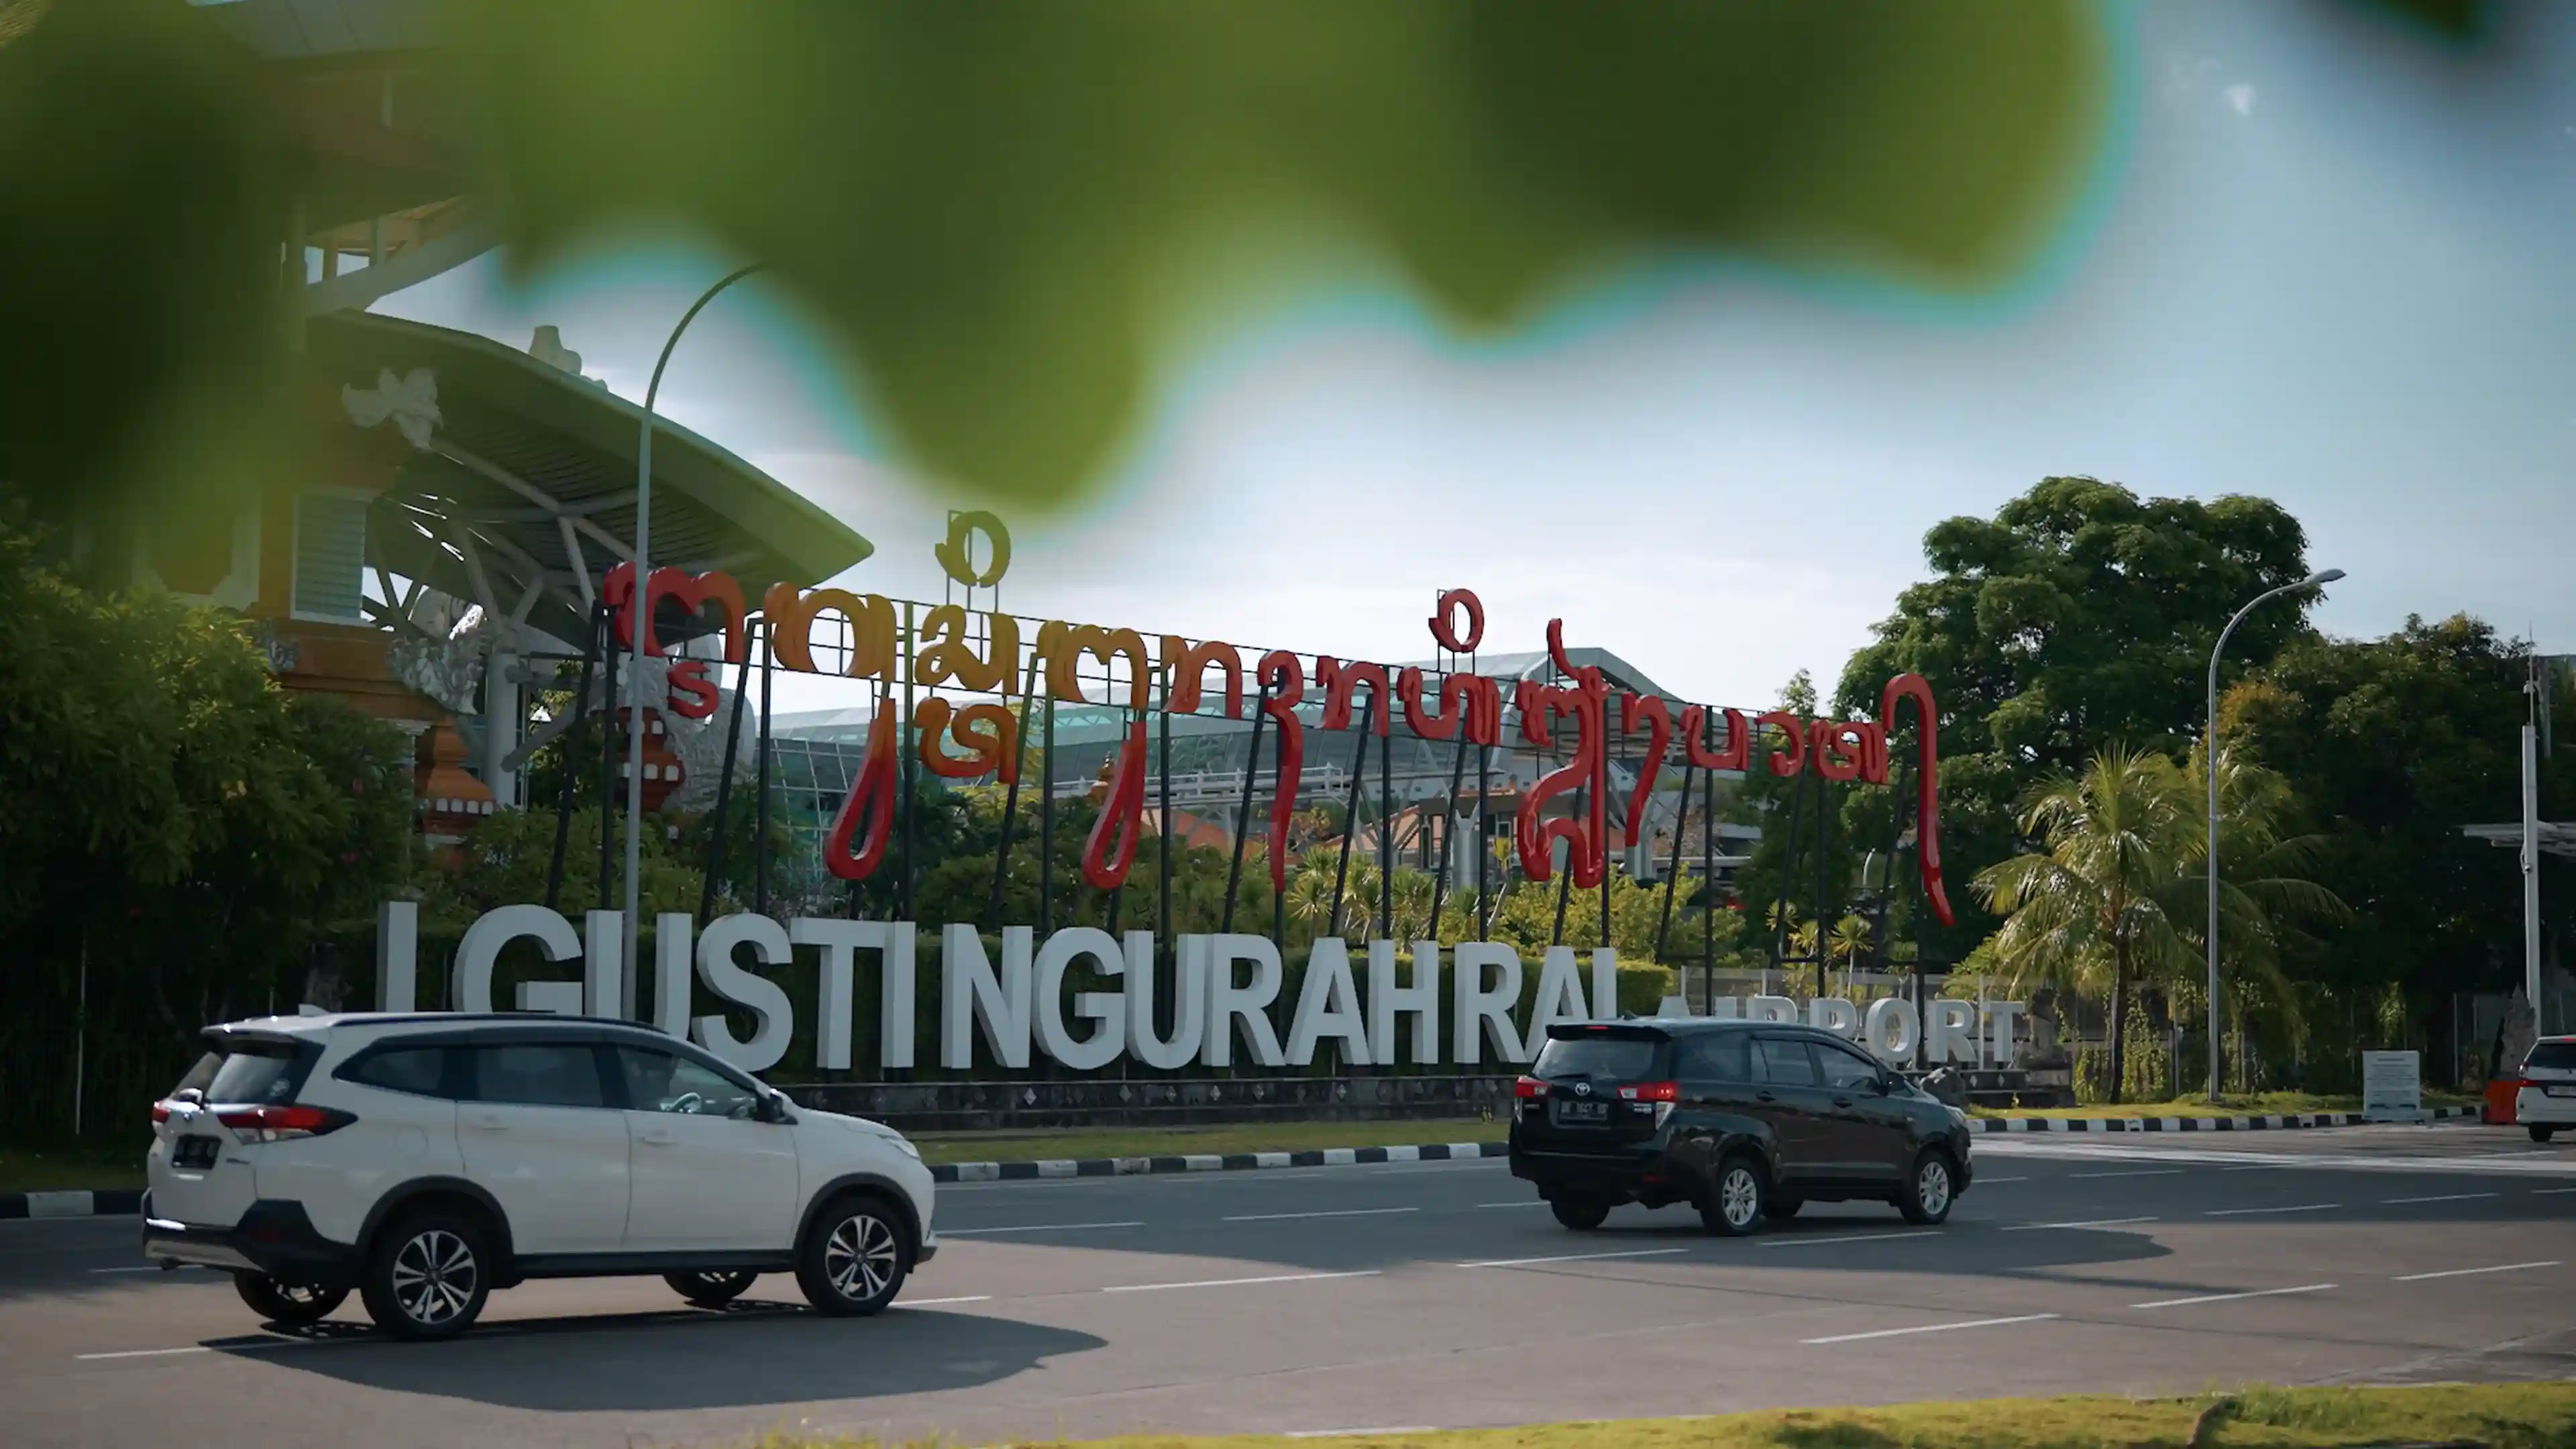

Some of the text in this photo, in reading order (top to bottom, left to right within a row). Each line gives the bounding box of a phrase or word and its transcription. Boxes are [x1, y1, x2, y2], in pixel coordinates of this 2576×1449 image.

[452, 904, 915, 1072] GUSTI
[941, 922, 1440, 1069] NGURAH
[1454, 941, 1618, 1064] RAI
